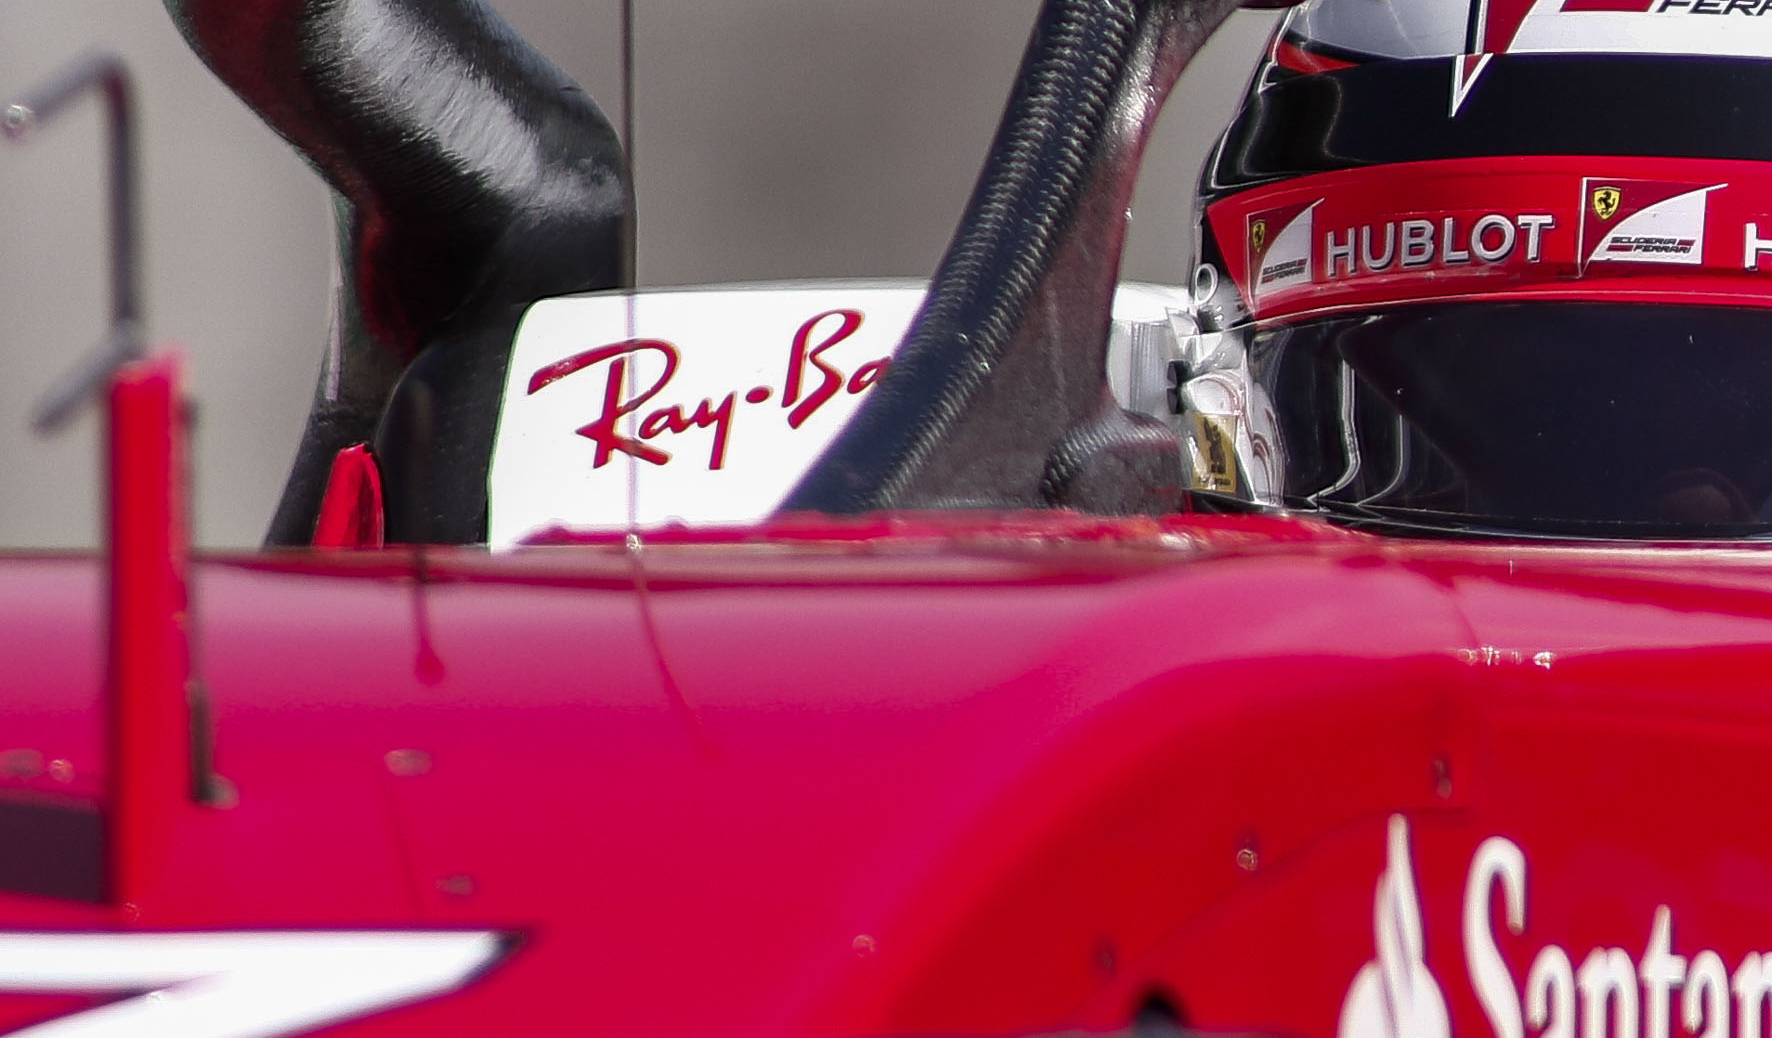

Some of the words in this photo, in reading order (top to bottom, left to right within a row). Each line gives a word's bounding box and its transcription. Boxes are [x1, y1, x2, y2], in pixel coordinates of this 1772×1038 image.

[1326, 214, 1555, 276] HUBLOT
[1611, 236, 1678, 245] SCUDERIA
[1633, 244, 1692, 254] FERRARI
[526, 307, 893, 469] Ray-Ba
